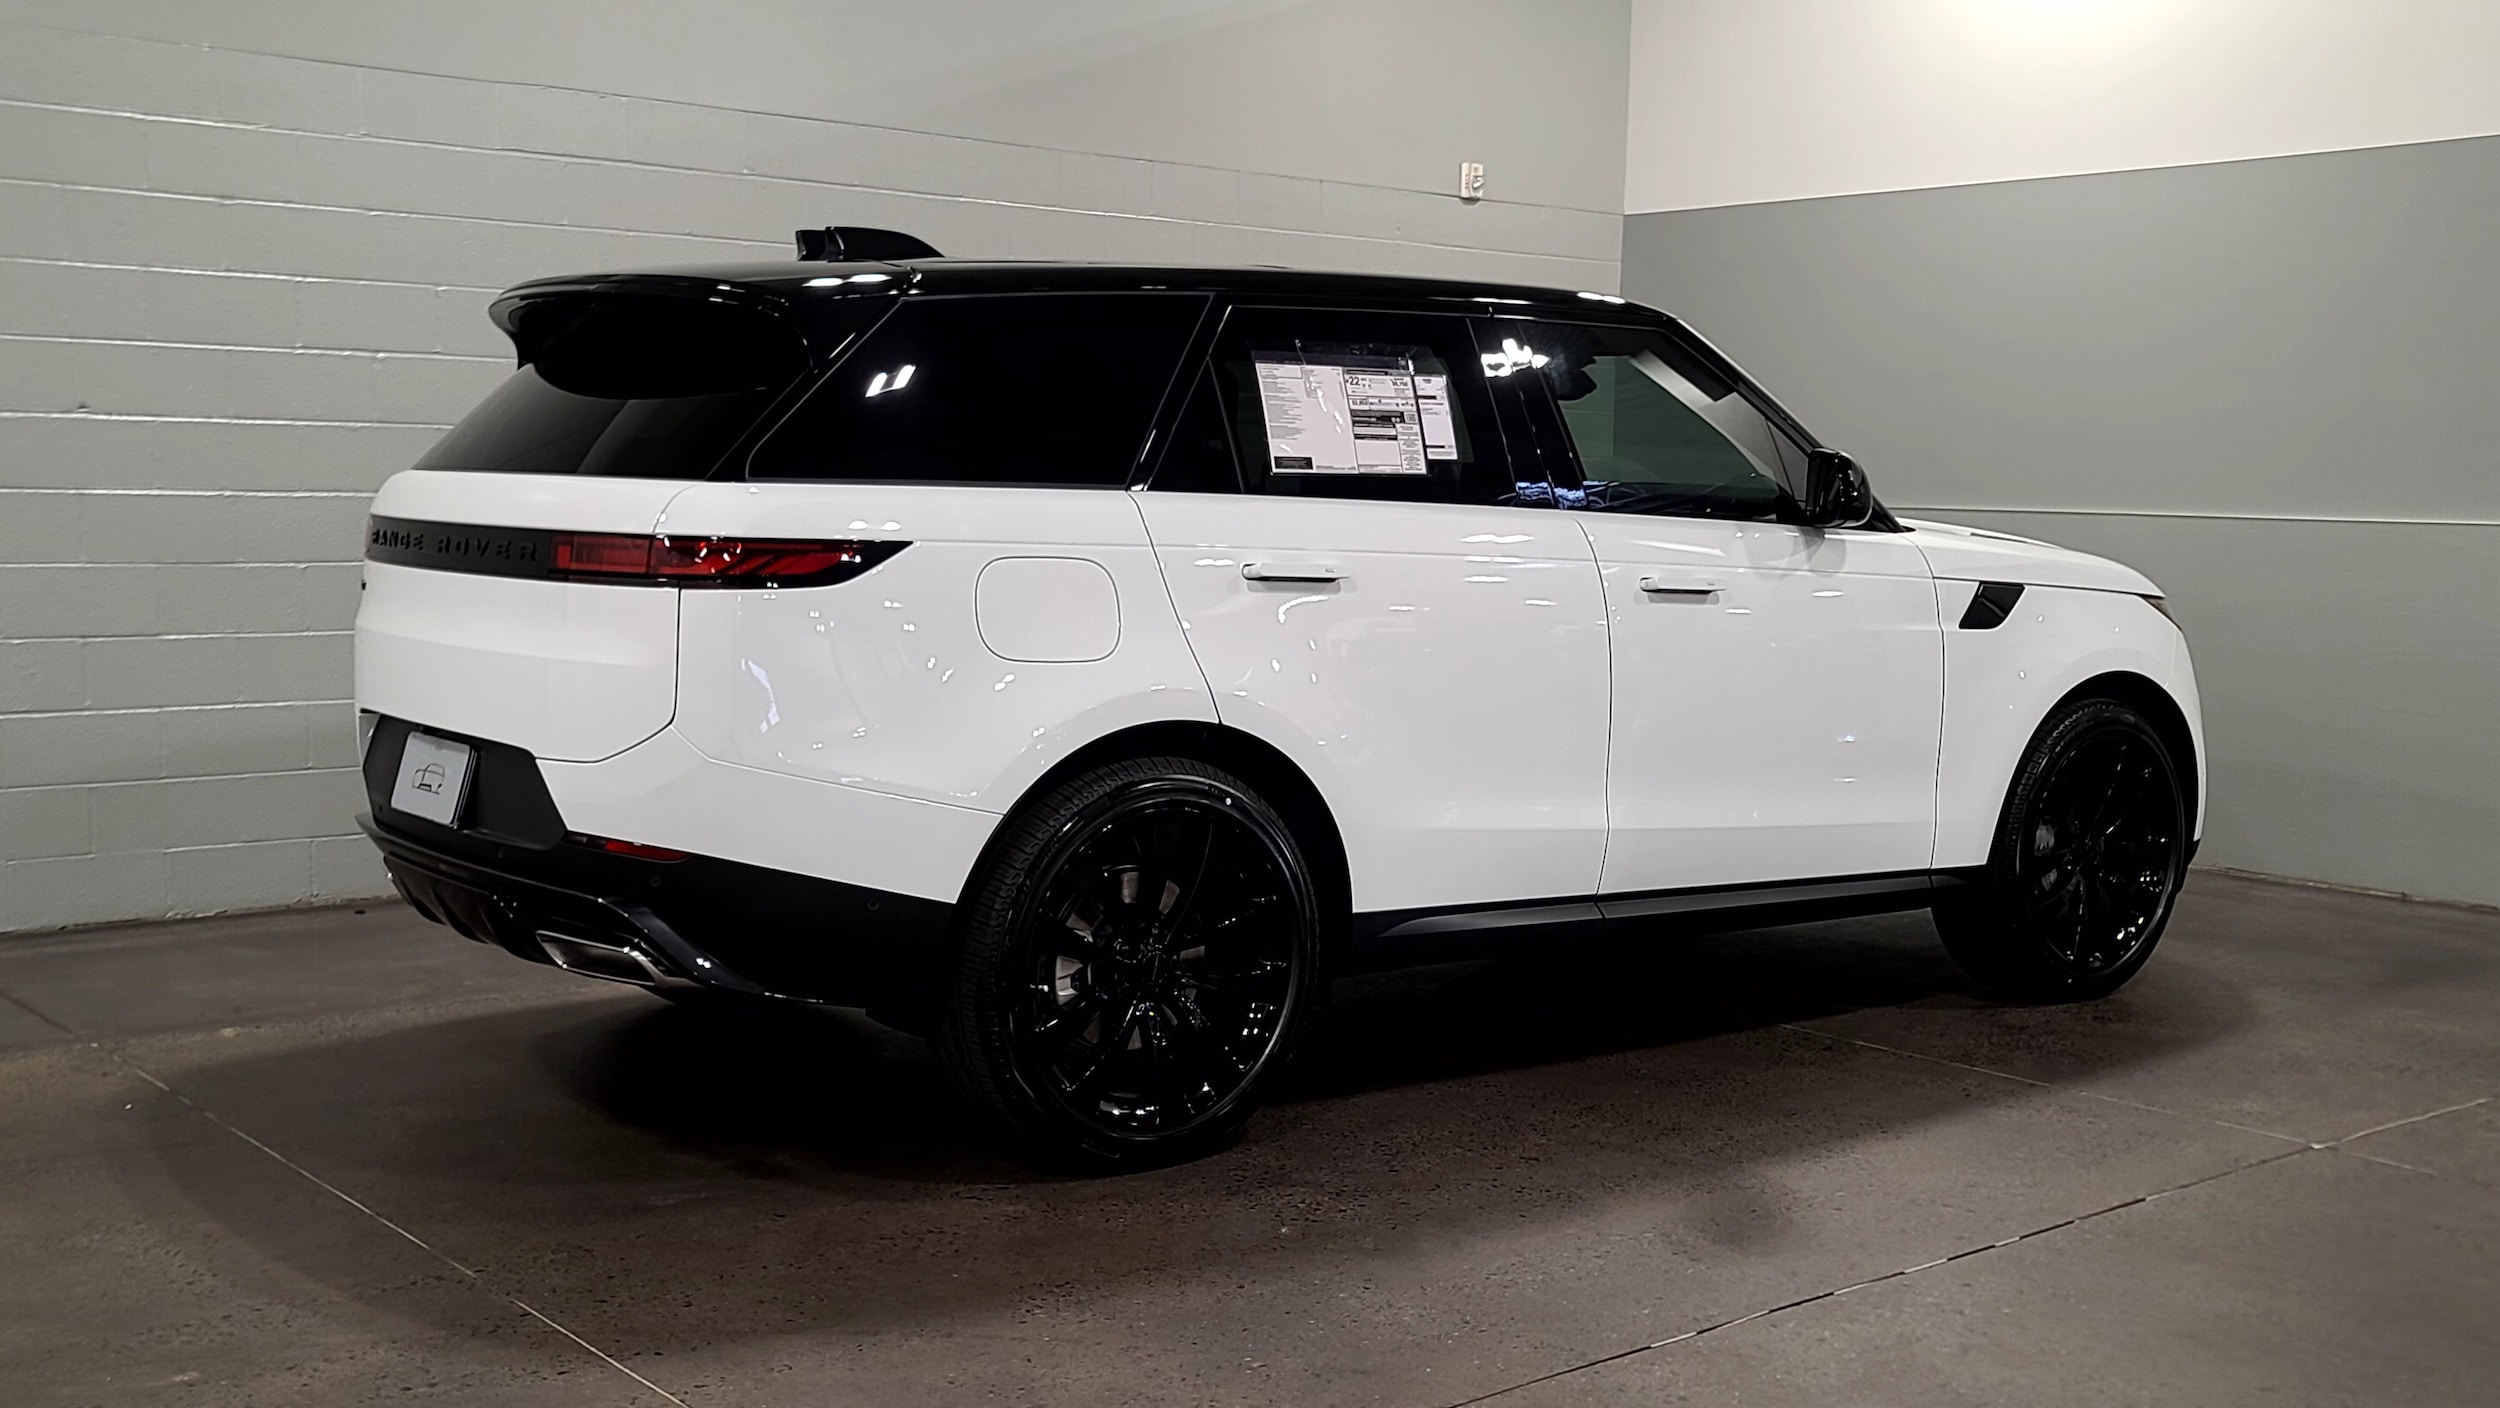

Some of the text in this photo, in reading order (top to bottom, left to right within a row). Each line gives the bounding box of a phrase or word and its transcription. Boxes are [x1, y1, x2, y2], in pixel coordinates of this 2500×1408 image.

[1349, 376, 1360, 386] 22
[372, 529, 538, 562] RANGE ROVER
